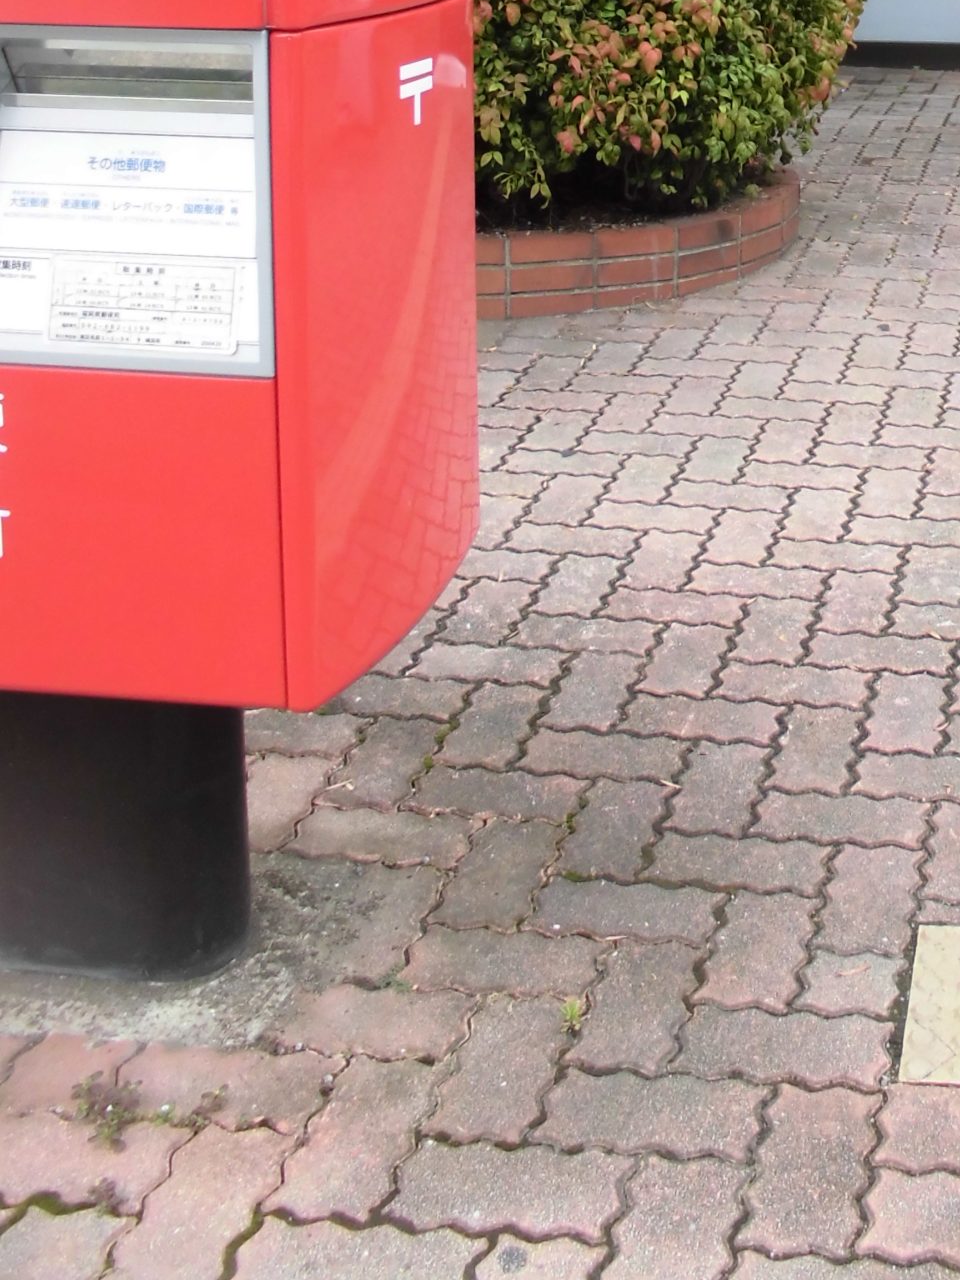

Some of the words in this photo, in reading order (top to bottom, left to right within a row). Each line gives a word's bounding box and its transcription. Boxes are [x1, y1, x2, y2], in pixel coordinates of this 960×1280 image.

[87, 156, 166, 173] その他郵便物
[0, 260, 32, 271] 集時刻
